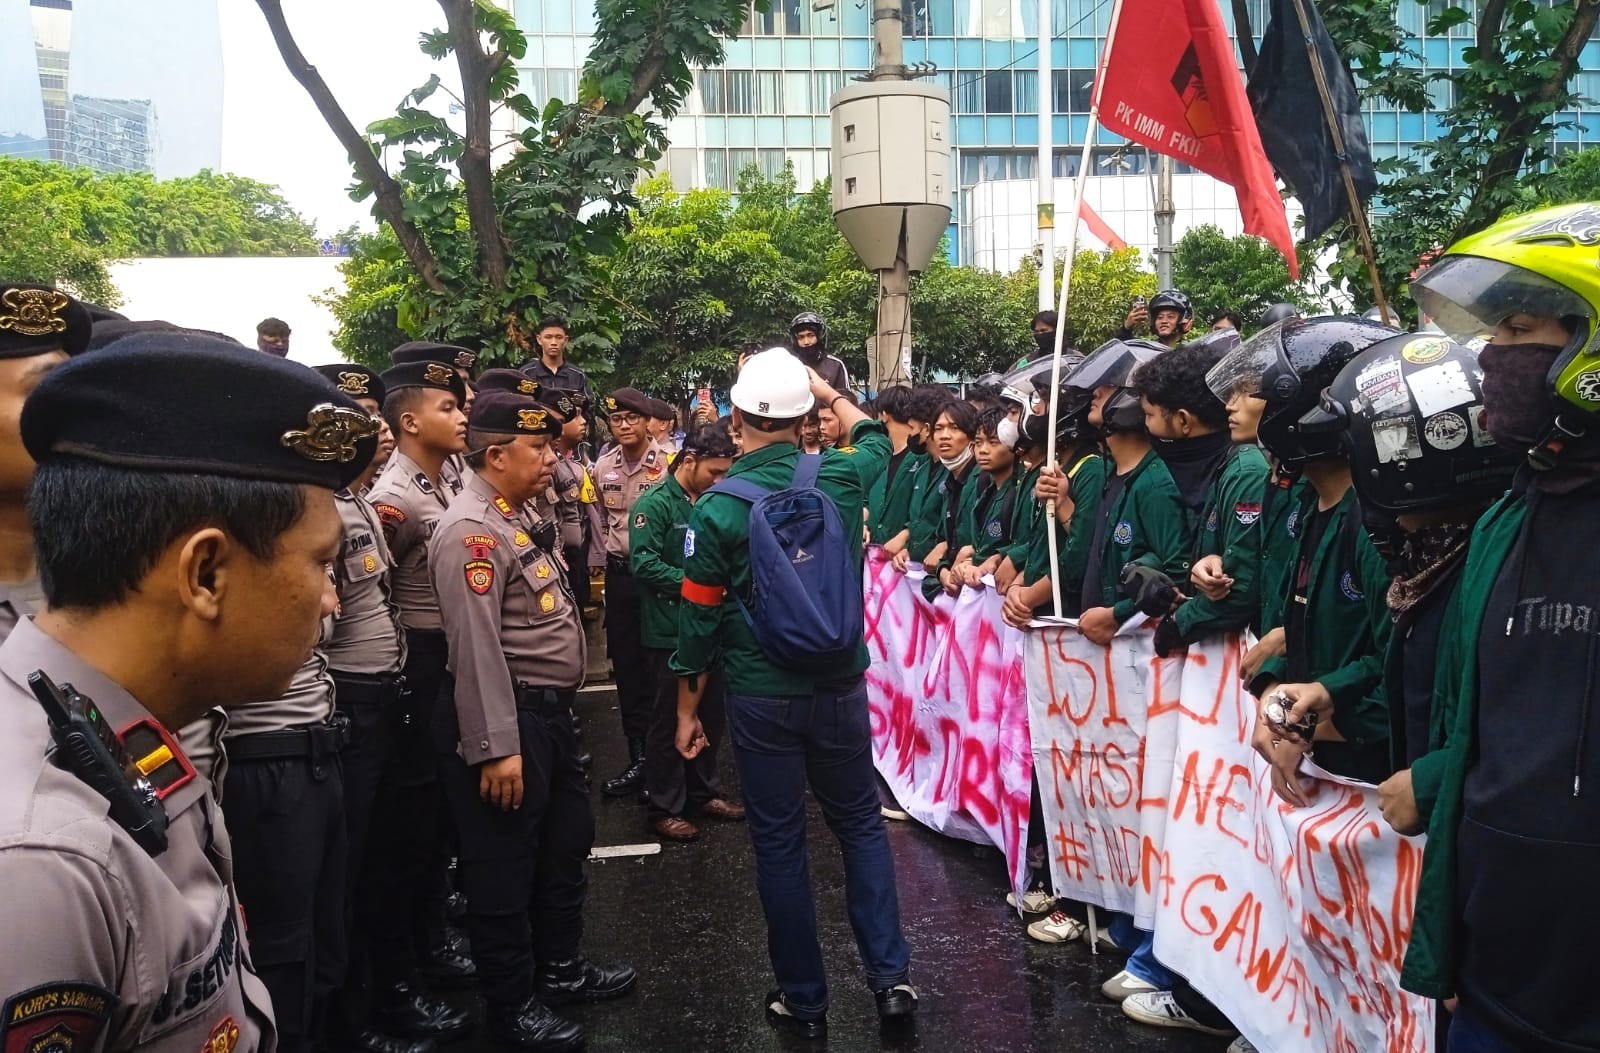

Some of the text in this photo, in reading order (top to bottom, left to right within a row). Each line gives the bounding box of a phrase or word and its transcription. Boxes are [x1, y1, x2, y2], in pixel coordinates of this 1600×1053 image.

[1114, 101, 1135, 126] PK
[1134, 113, 1165, 141] IMM
[13, 992, 59, 1020] KORPS
